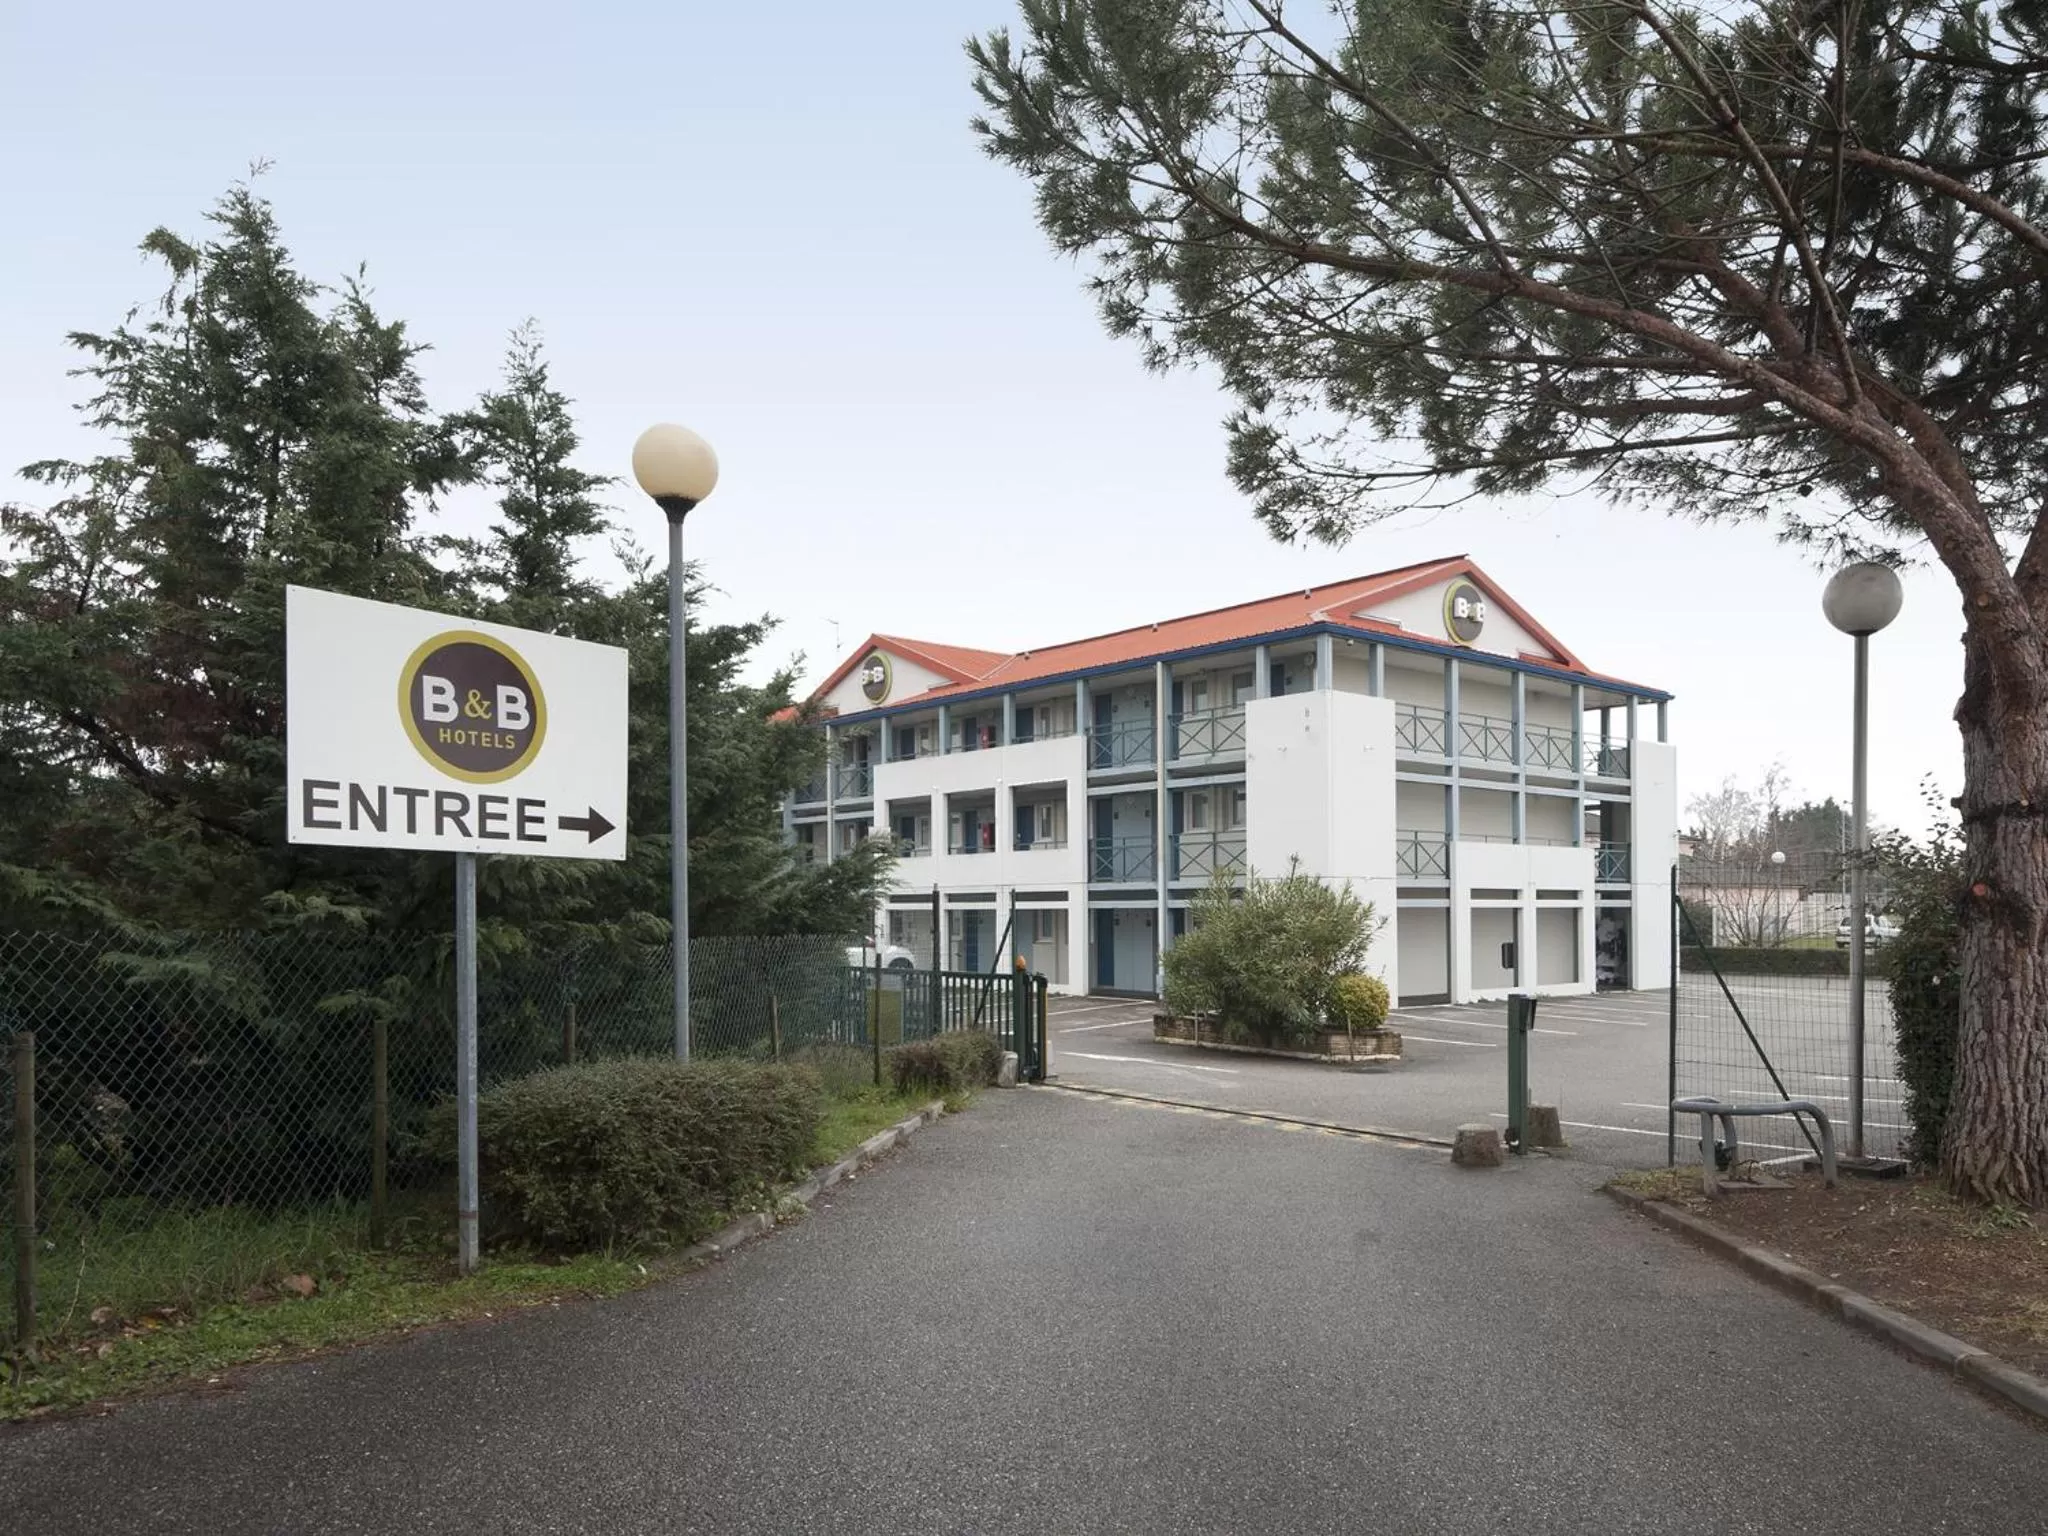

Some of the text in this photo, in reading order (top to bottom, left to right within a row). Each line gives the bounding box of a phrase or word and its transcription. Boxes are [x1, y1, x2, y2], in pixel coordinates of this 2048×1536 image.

[422, 675, 531, 730] B&B
[438, 727, 516, 750] HOTELS
[302, 778, 548, 843] ENTREE
